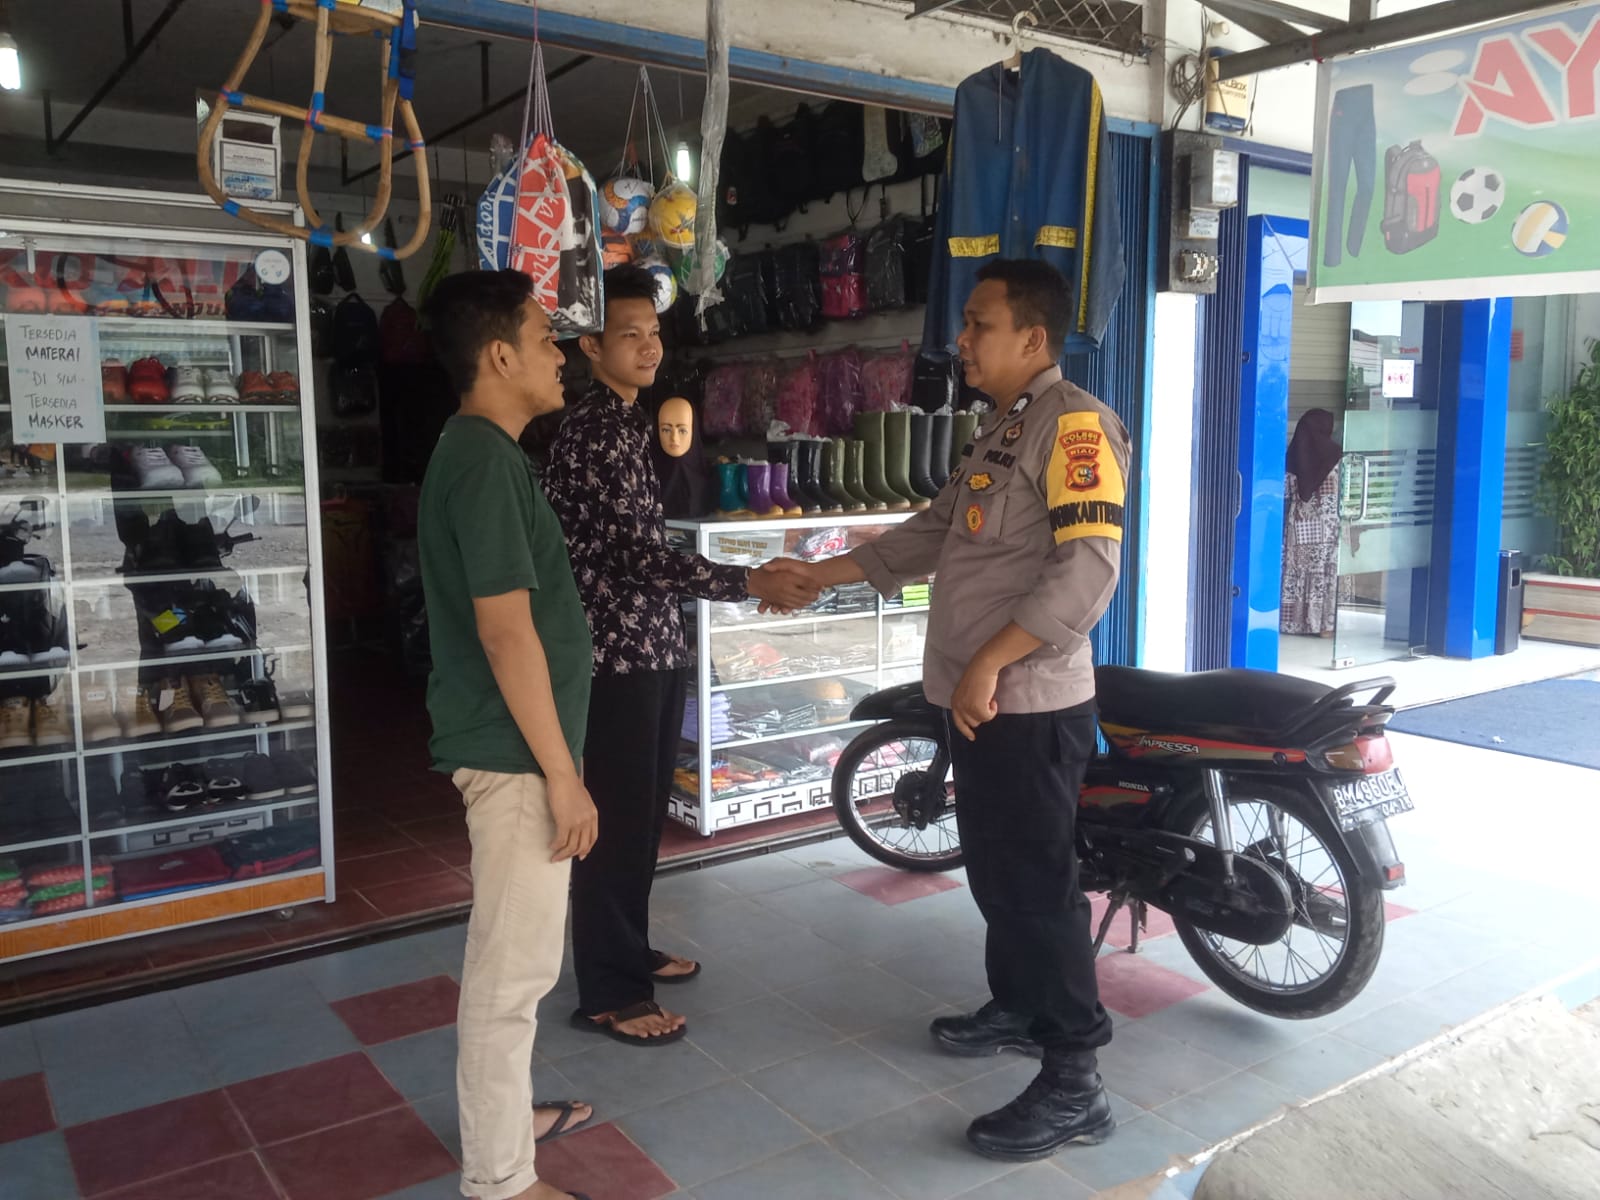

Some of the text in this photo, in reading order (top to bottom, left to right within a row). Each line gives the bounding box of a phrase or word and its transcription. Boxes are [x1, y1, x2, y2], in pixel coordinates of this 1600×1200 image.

[19, 325, 77, 342] TERSEDIA
[25, 346, 80, 362] MATERAI
[32, 371, 47, 386] DI
[24, 393, 77, 409] TERSEDIA
[28, 412, 84, 429] MASKER
[1118, 780, 1150, 792] HONDA
